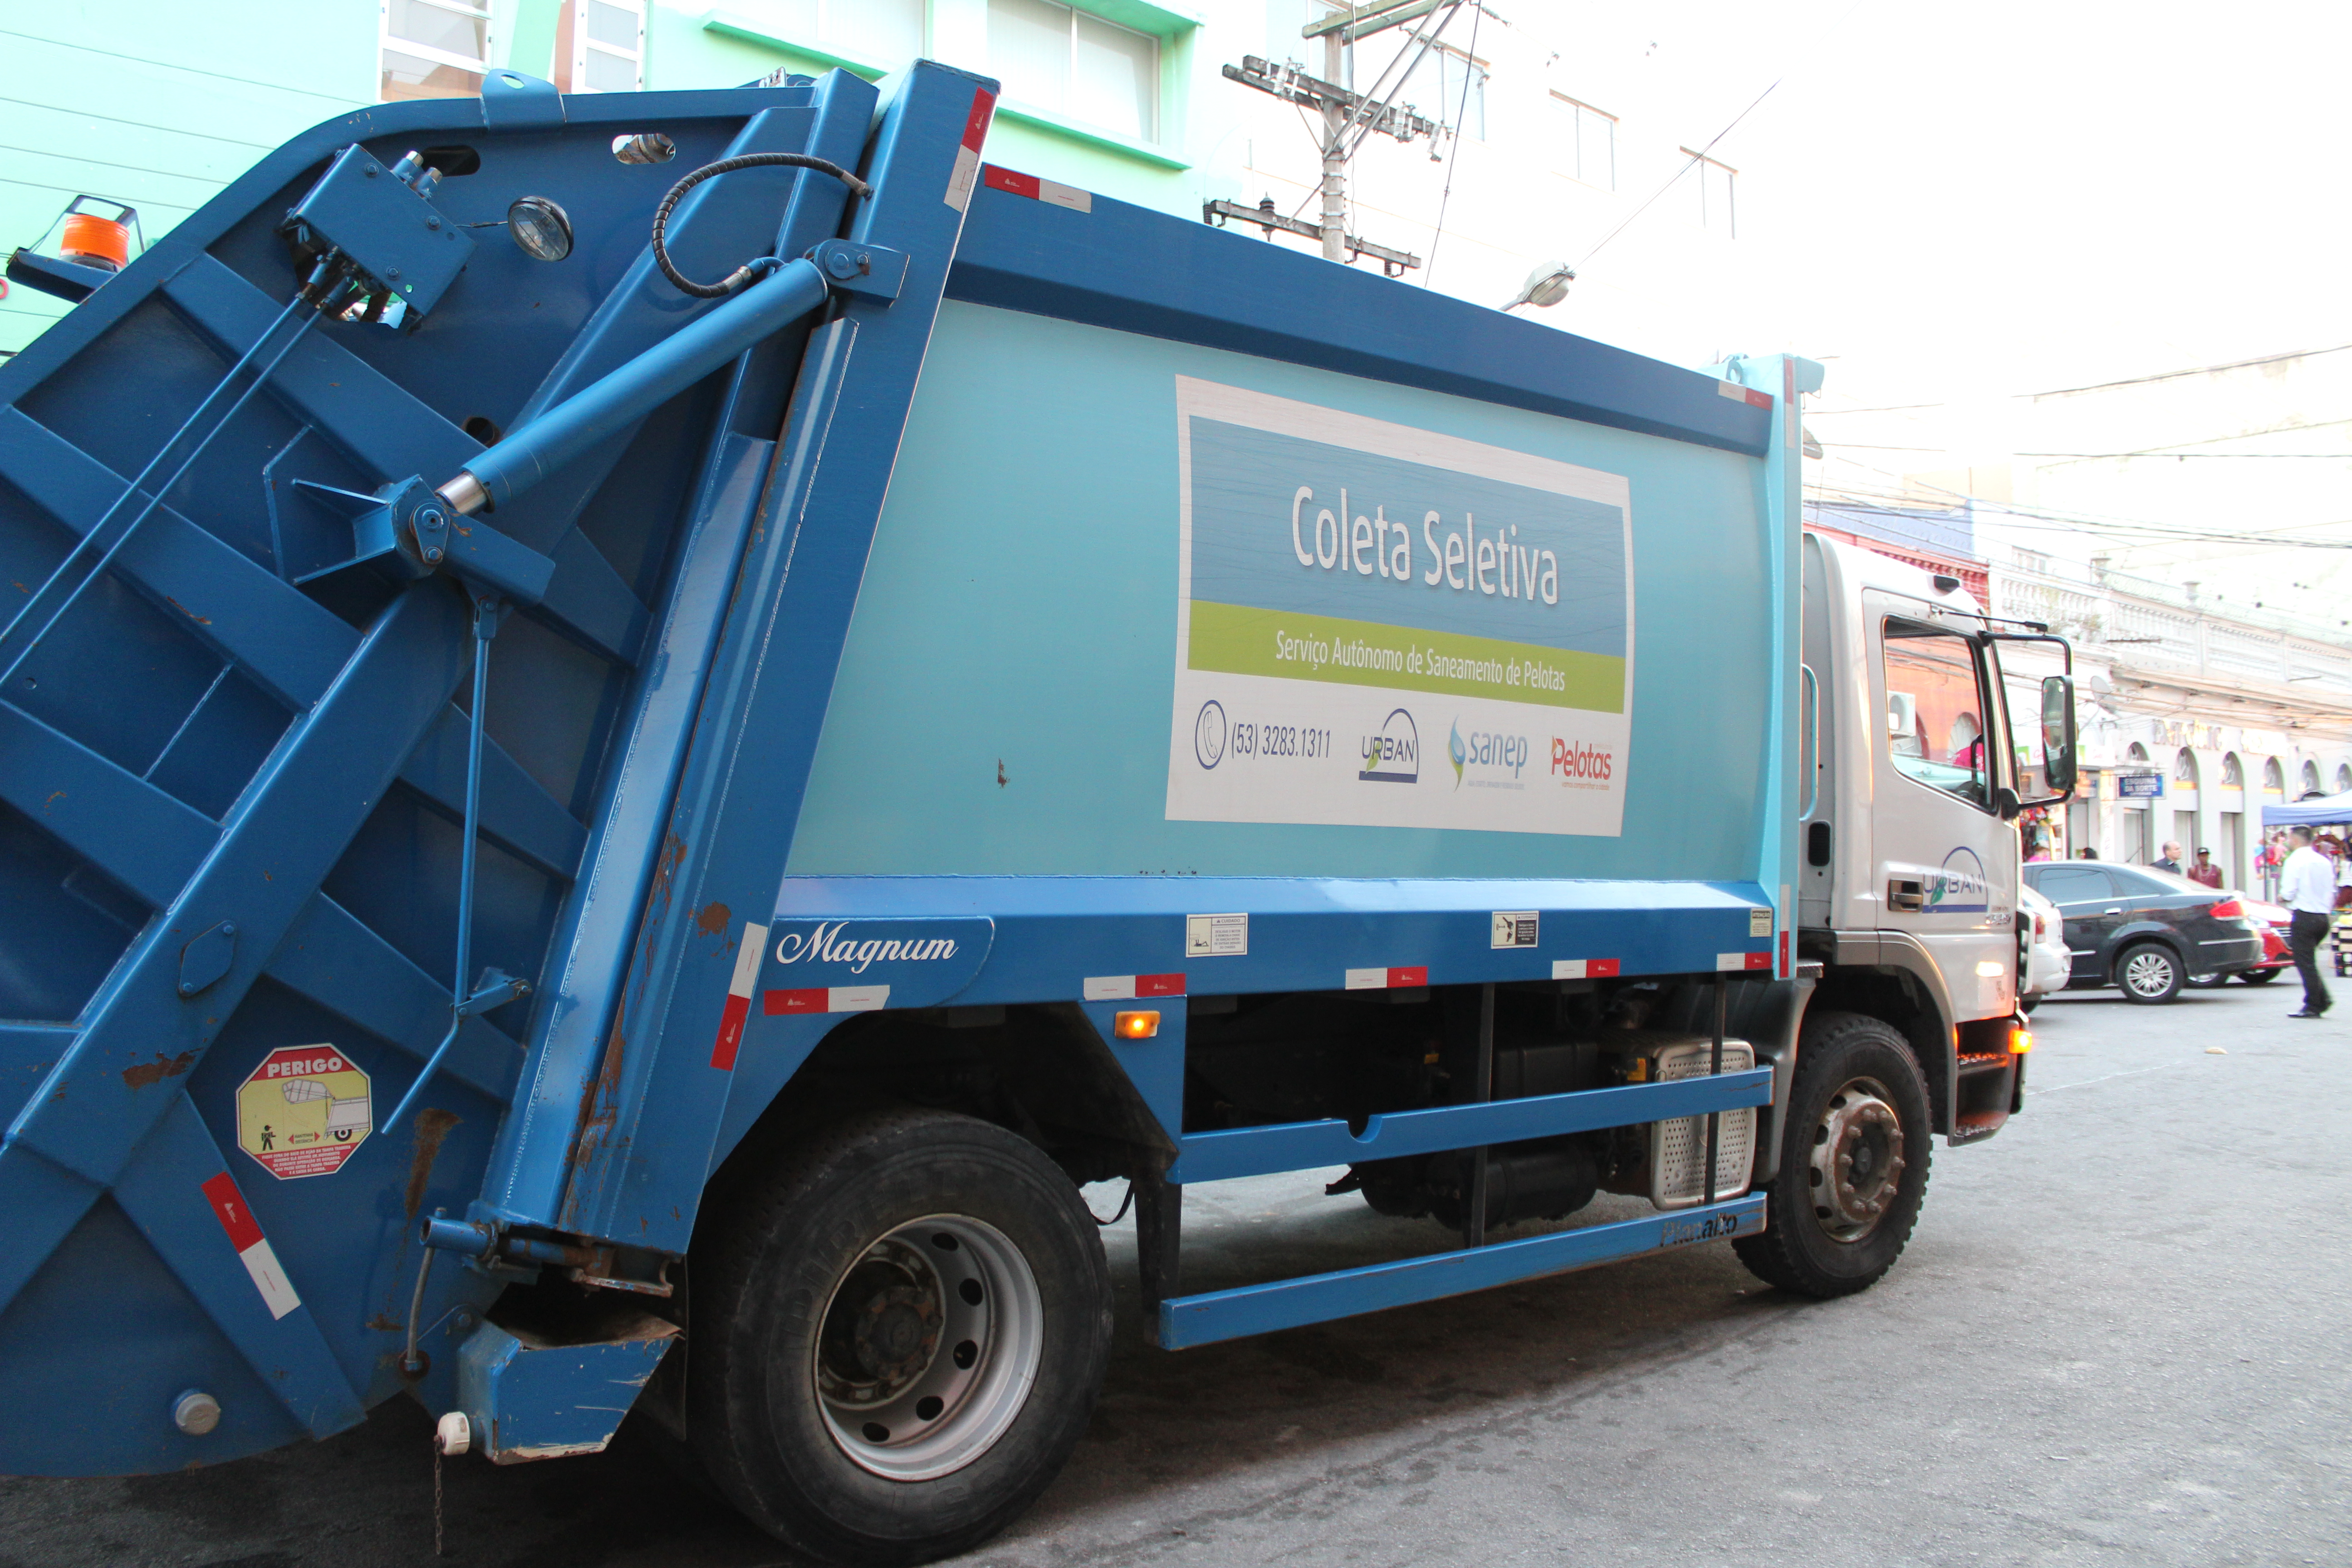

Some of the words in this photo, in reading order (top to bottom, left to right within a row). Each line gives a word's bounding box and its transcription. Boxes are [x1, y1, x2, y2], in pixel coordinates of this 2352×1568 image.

[1293, 486, 1411, 581] Coleta
[1424, 510, 1558, 605] Seletiva
[1276, 630, 1328, 670] Serviço
[1332, 637, 1402, 672] Autônomo
[1407, 644, 1423, 674] de
[1426, 648, 1503, 684] Saneamento
[1506, 657, 1520, 686] de
[1524, 661, 1565, 691] Pelotas
[1231, 722, 1258, 760] (53)
[1262, 725, 1331, 758] 3283.1311
[1362, 735, 1416, 763] URBAN
[1469, 731, 1528, 779] sanep
[1551, 737, 1612, 780] Pelotas
[1923, 872, 1982, 894] URBAN
[776, 921, 959, 974] Magnum
[267, 1057, 343, 1078] PERIGO
